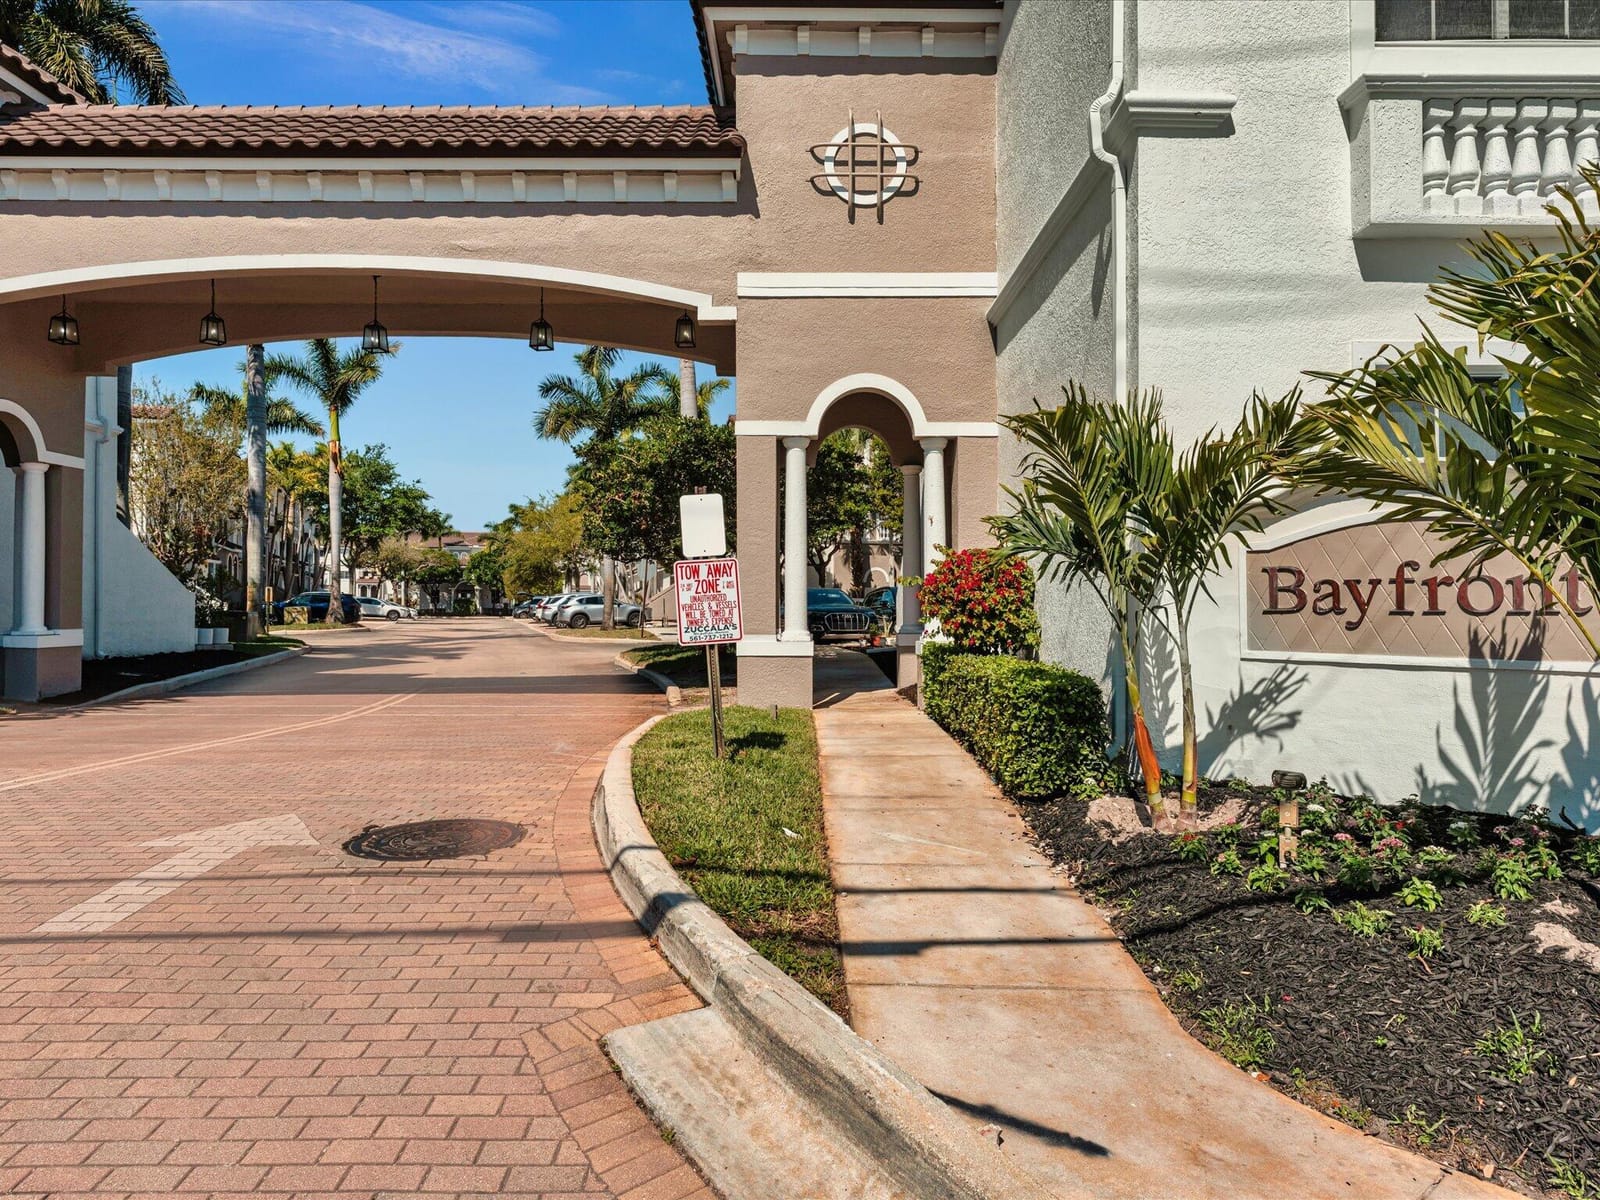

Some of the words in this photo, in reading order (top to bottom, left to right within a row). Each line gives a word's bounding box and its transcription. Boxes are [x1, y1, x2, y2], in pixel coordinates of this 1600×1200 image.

[679, 565, 700, 580] TOW
[706, 562, 734, 579] AWAY
[694, 578, 721, 594] ZONE
[690, 594, 727, 603] UNAUTHORIZED
[1261, 560, 1593, 631] Bayfront
[681, 603, 704, 611] VEHICLES
[708, 602, 713, 610] &
[716, 601, 737, 609] VESSELS
[685, 611, 696, 619] WILL
[710, 609, 726, 618] TOWED
[728, 609, 734, 617] AT
[711, 617, 734, 626] EXPENSE
[684, 624, 738, 633] ZUCCALA'S
